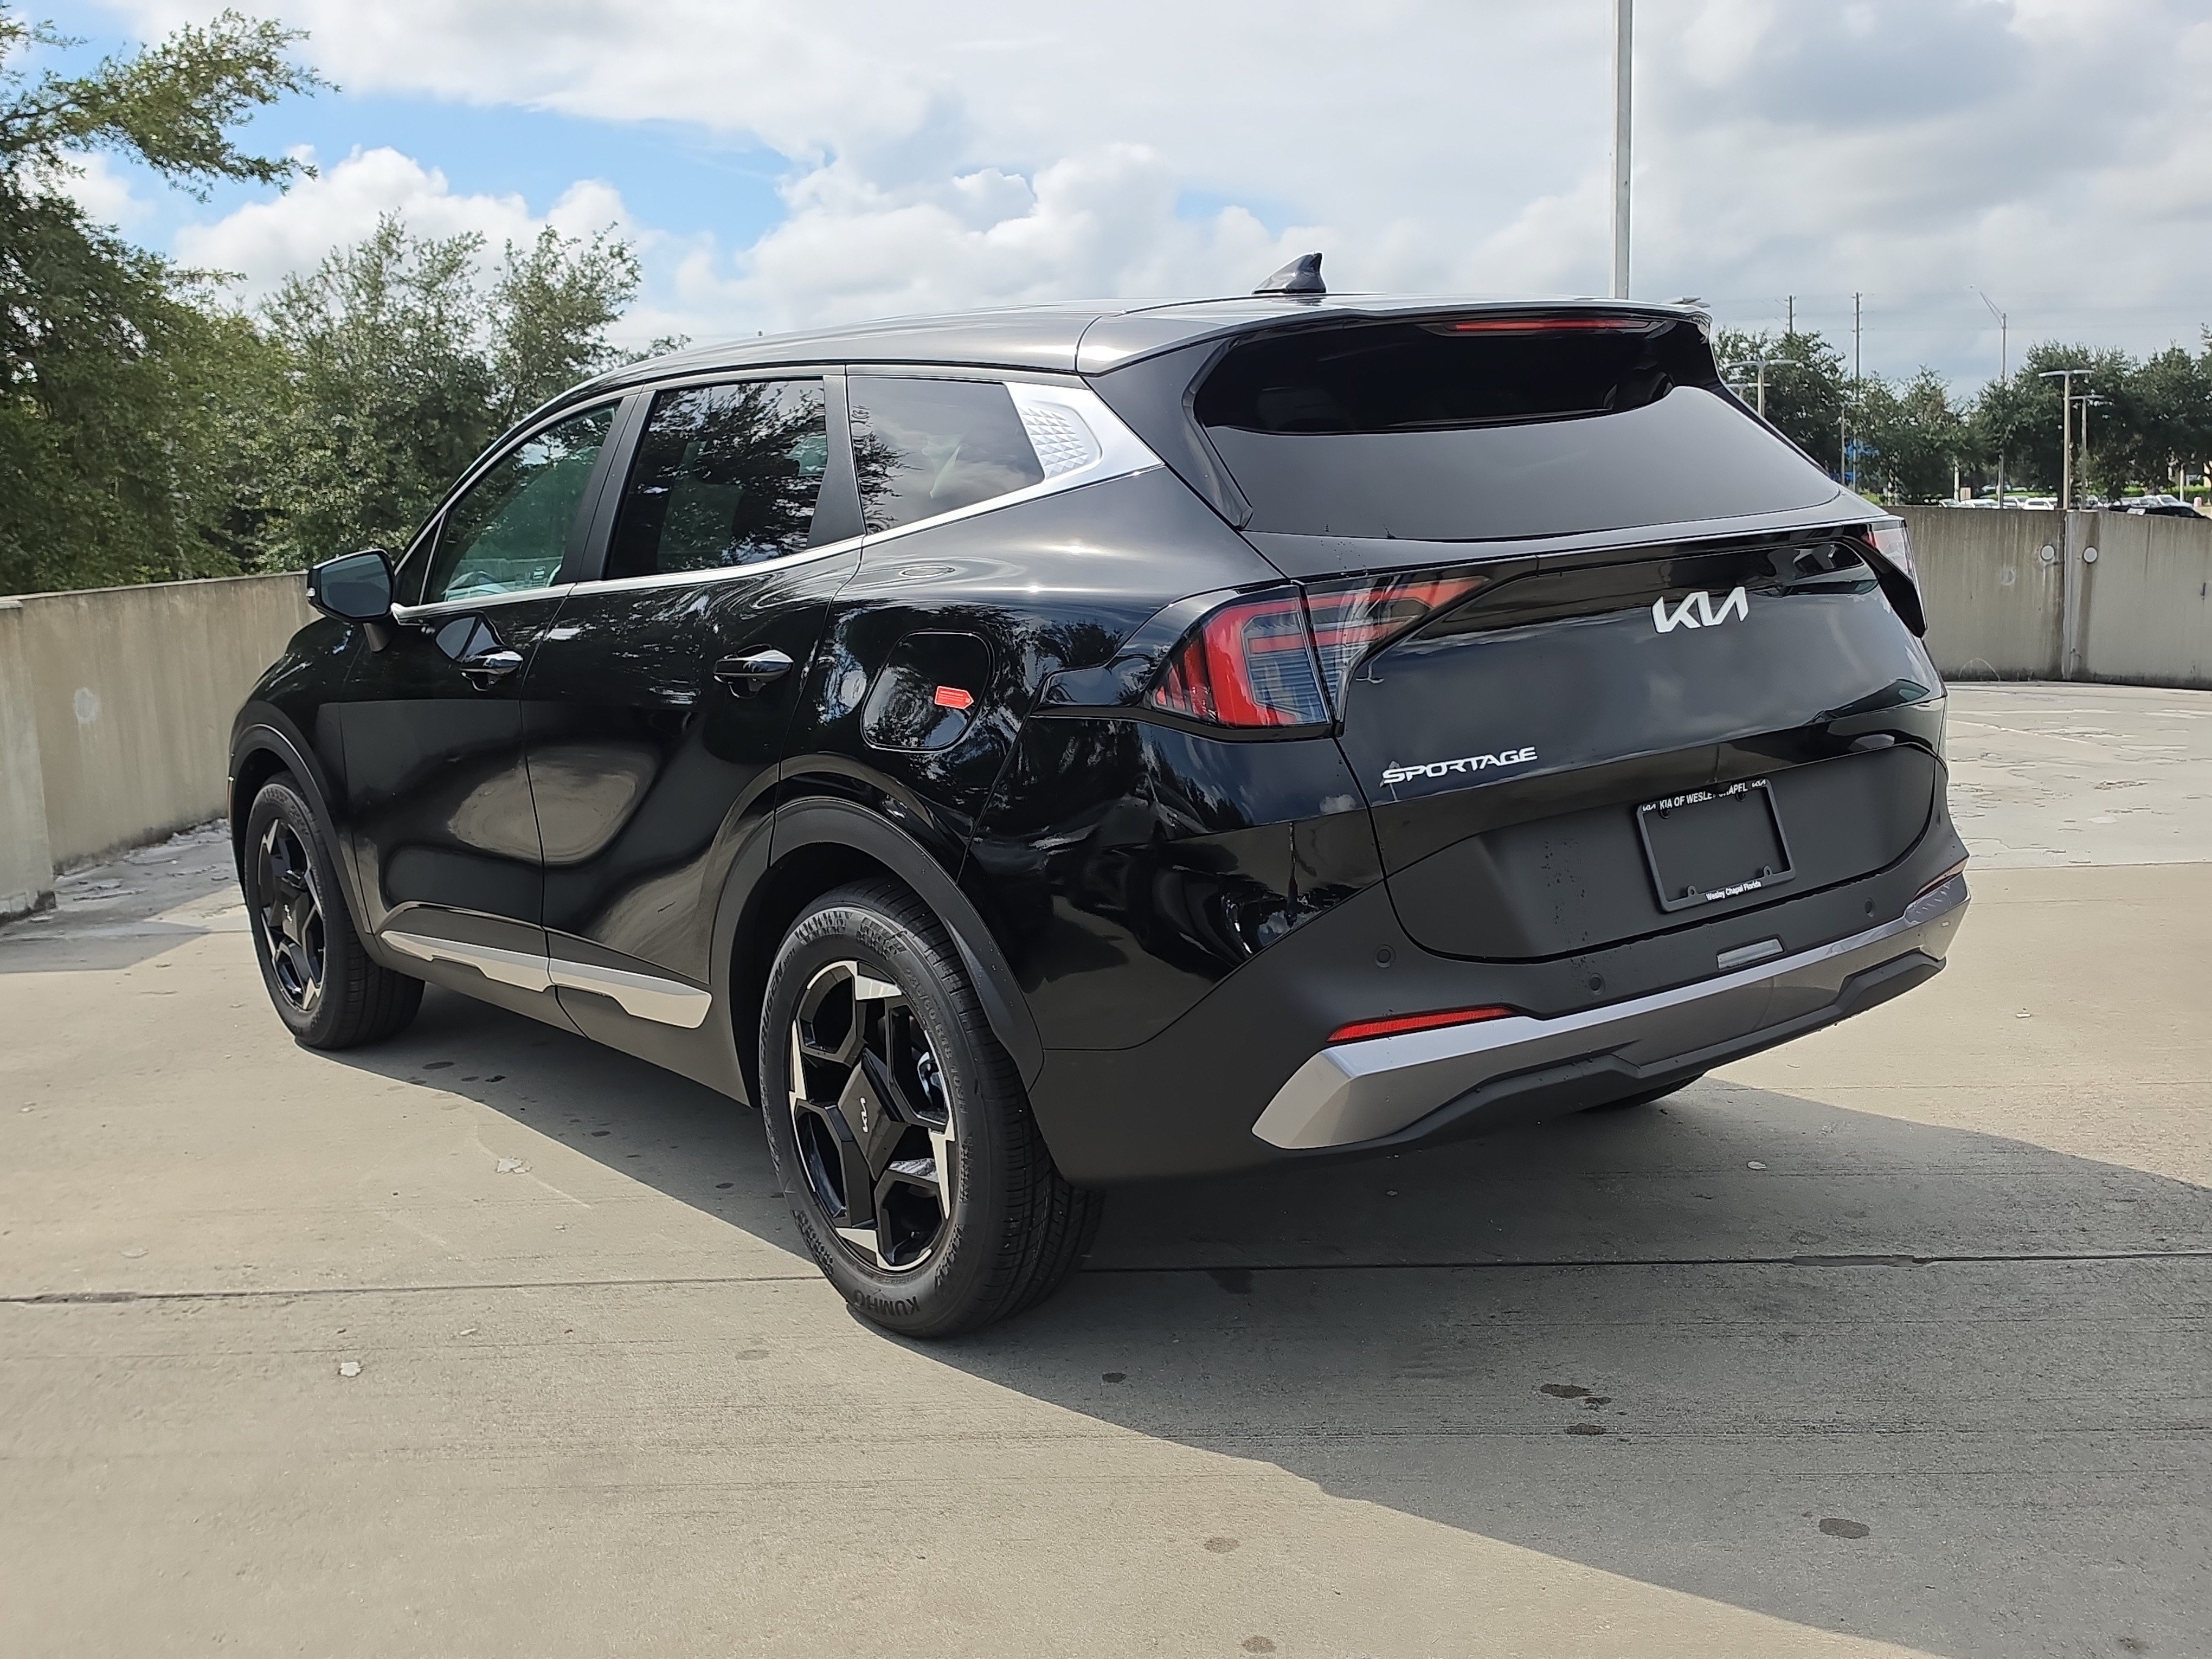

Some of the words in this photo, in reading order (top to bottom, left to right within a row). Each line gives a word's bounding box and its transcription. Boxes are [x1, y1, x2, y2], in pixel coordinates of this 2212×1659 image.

[1652, 586, 1749, 633] KIA
[1382, 746, 1538, 784] SPORTAGE
[1659, 798, 1673, 811] KIA
[1673, 795, 1685, 807] OF
[1686, 791, 1716, 804] WESLE
[1718, 782, 1748, 797] APEL
[1706, 890, 1725, 901] Wesley
[1725, 884, 1744, 896] Chapel
[1743, 879, 1761, 891] Florida
[853, 1289, 921, 1317] KUMHO
